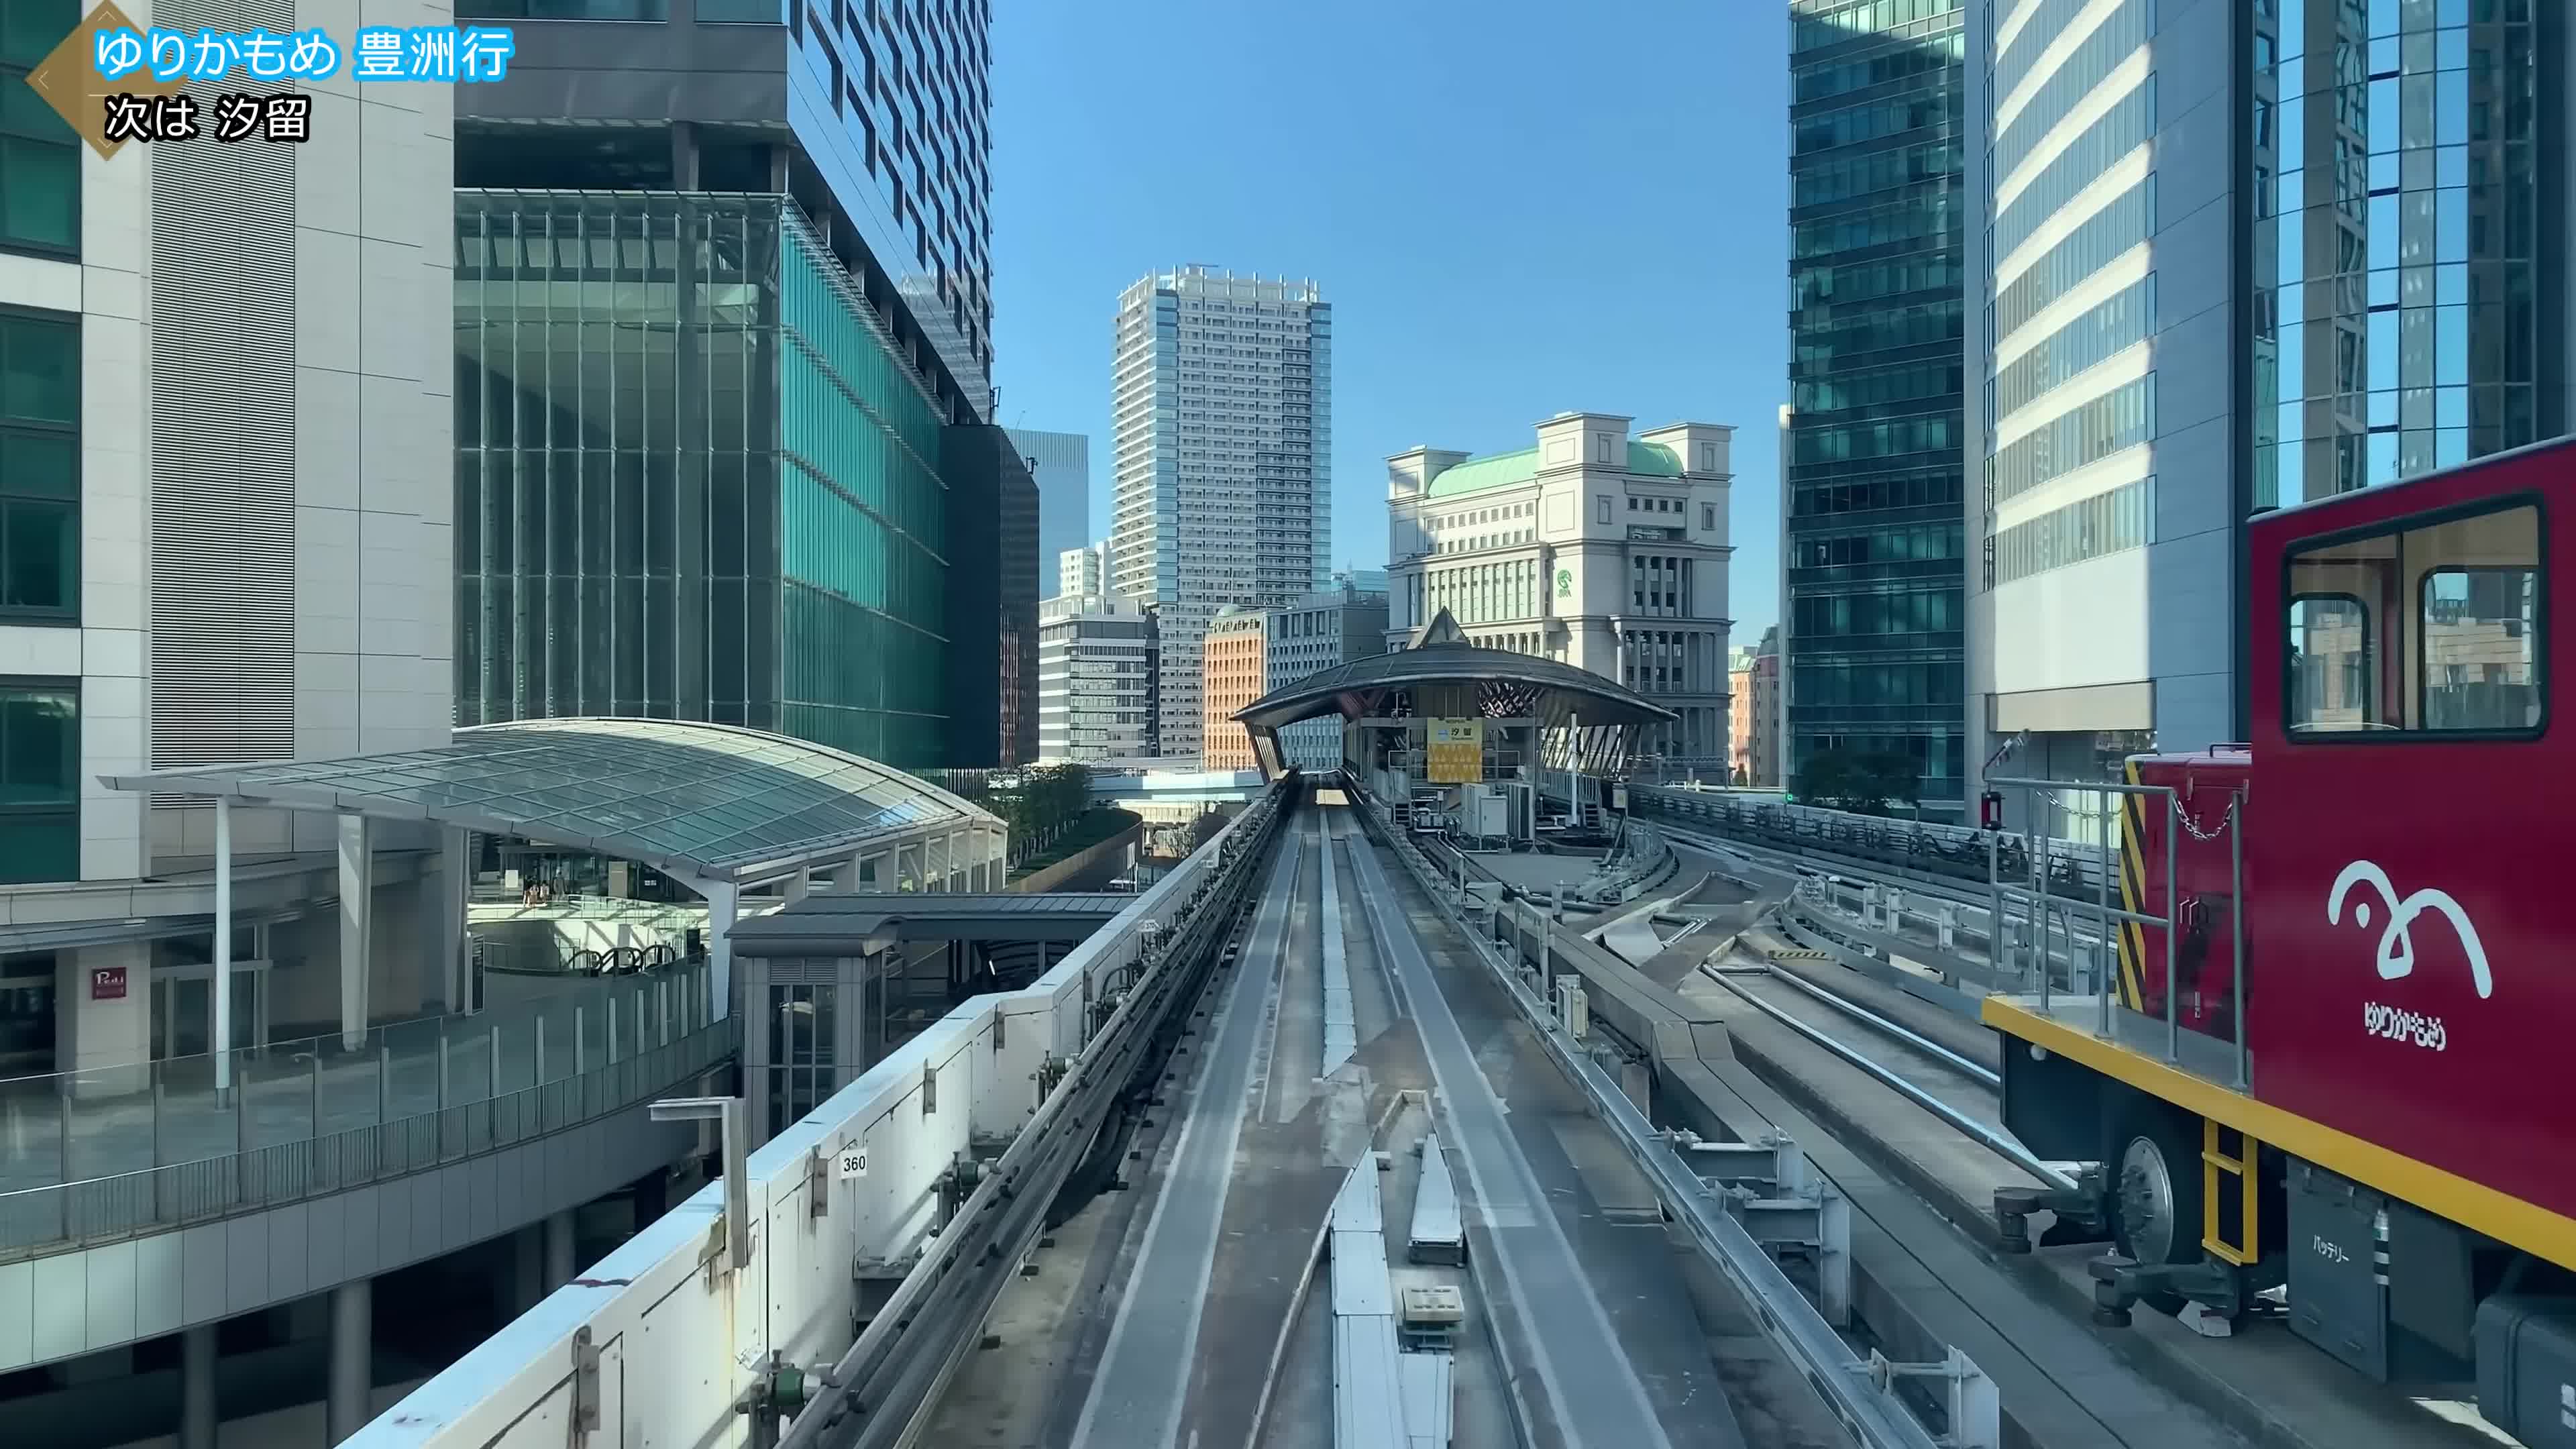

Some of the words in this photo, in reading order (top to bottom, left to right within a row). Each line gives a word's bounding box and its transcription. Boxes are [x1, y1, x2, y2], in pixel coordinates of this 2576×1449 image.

[2363, 1000, 2447, 1052] ゆりかもめ
[843, 1155, 866, 1173] 360
[2313, 1234, 2350, 1263] バッテリー
